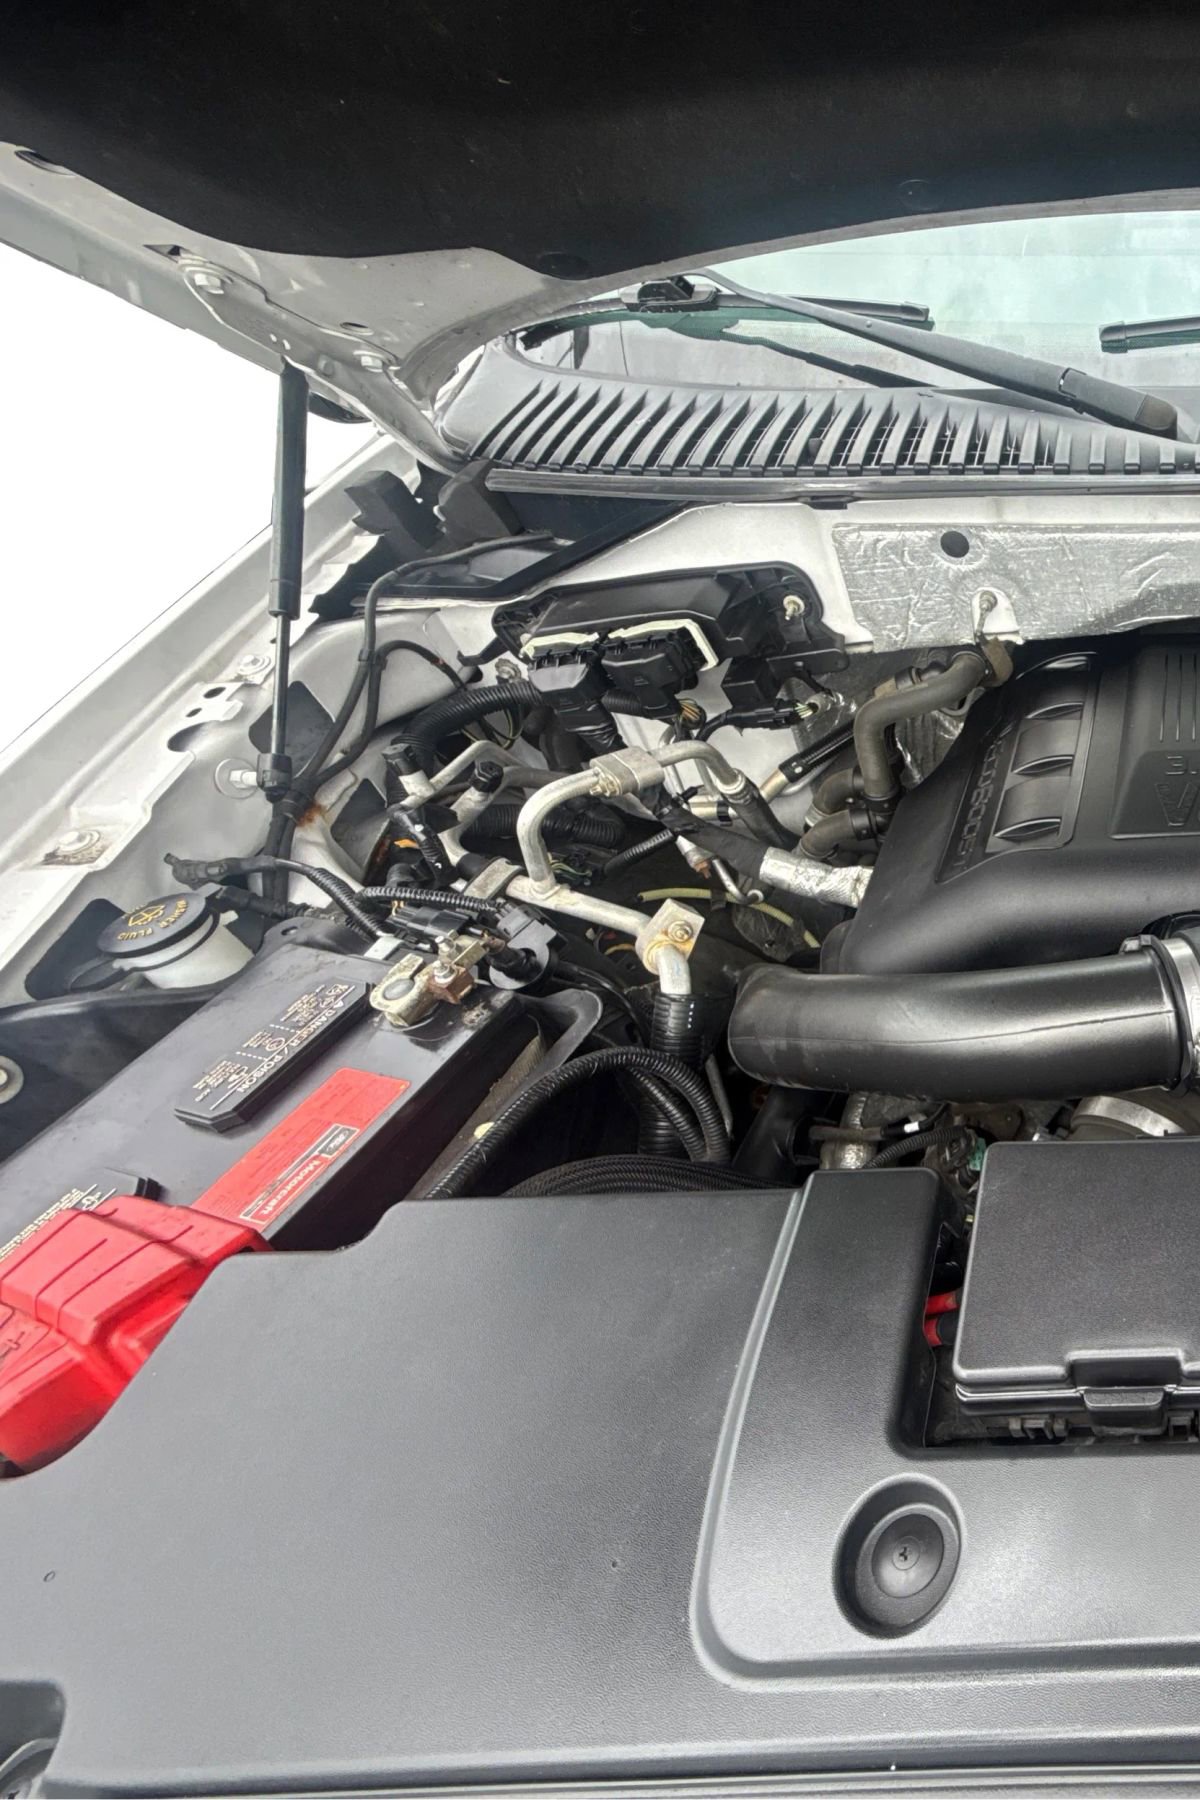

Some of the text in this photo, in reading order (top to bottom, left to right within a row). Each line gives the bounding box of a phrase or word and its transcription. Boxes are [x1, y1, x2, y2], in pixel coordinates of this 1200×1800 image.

[291, 1009, 337, 1047] DANGER
[237, 1055, 283, 1093] POISON
[260, 1159, 321, 1215] Motorcraft
